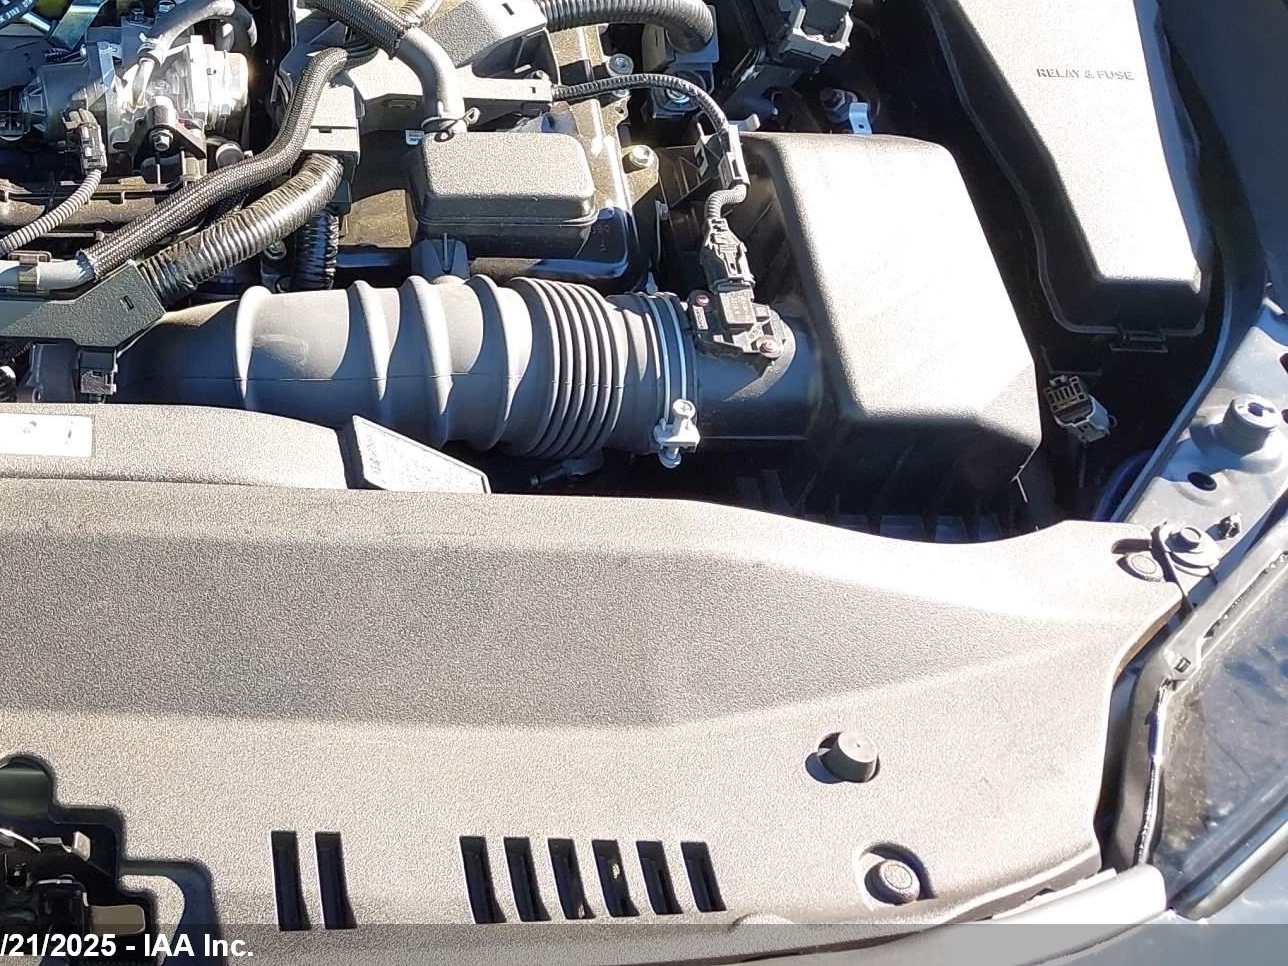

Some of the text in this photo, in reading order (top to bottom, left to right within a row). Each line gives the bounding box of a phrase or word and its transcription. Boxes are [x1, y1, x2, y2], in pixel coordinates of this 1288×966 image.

[1036, 68, 1135, 81] RELAY & FUSE
